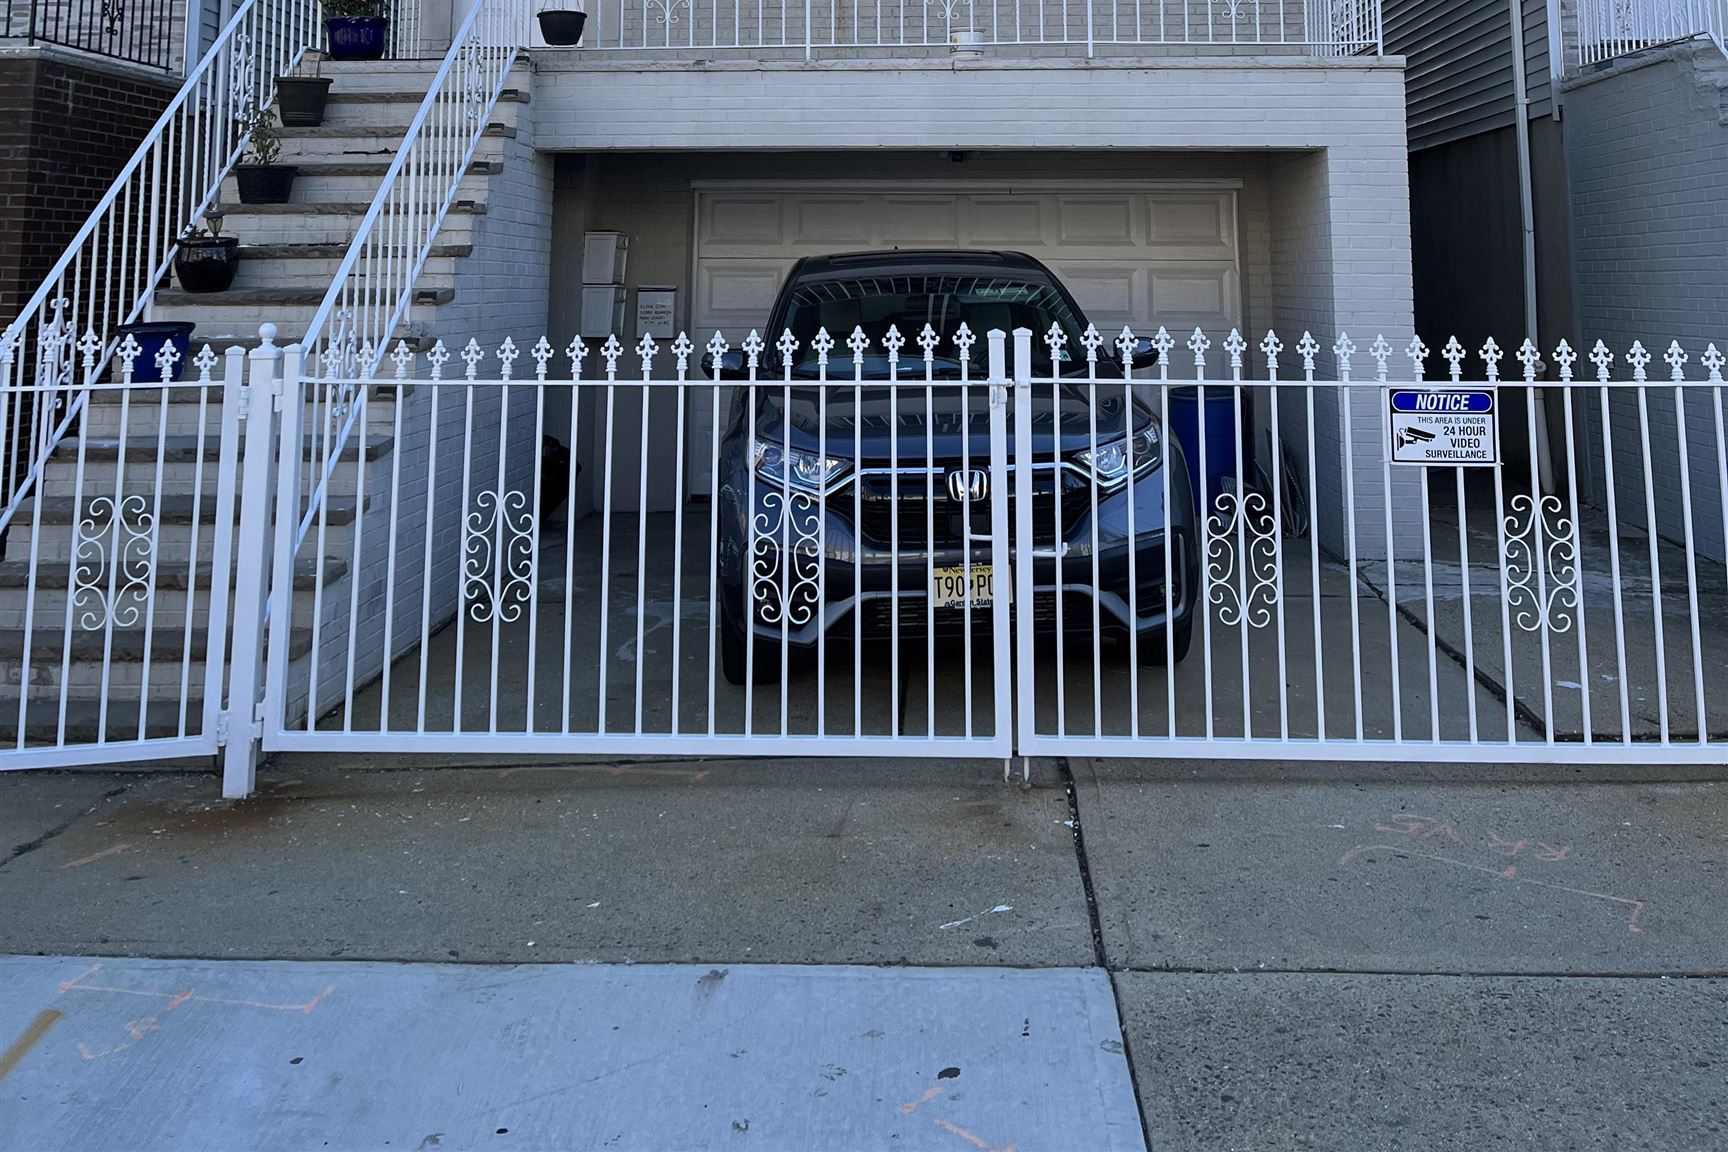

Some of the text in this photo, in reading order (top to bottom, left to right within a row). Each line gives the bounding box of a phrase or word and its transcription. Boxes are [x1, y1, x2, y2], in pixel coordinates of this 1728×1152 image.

[1416, 394, 1470, 410] NOTICE
[1417, 416, 1433, 424] THIS
[1443, 426, 1486, 436] 24 HOUR
[1450, 438, 1480, 448] VIDEO
[1425, 450, 1487, 459] SURVEILLANCE
